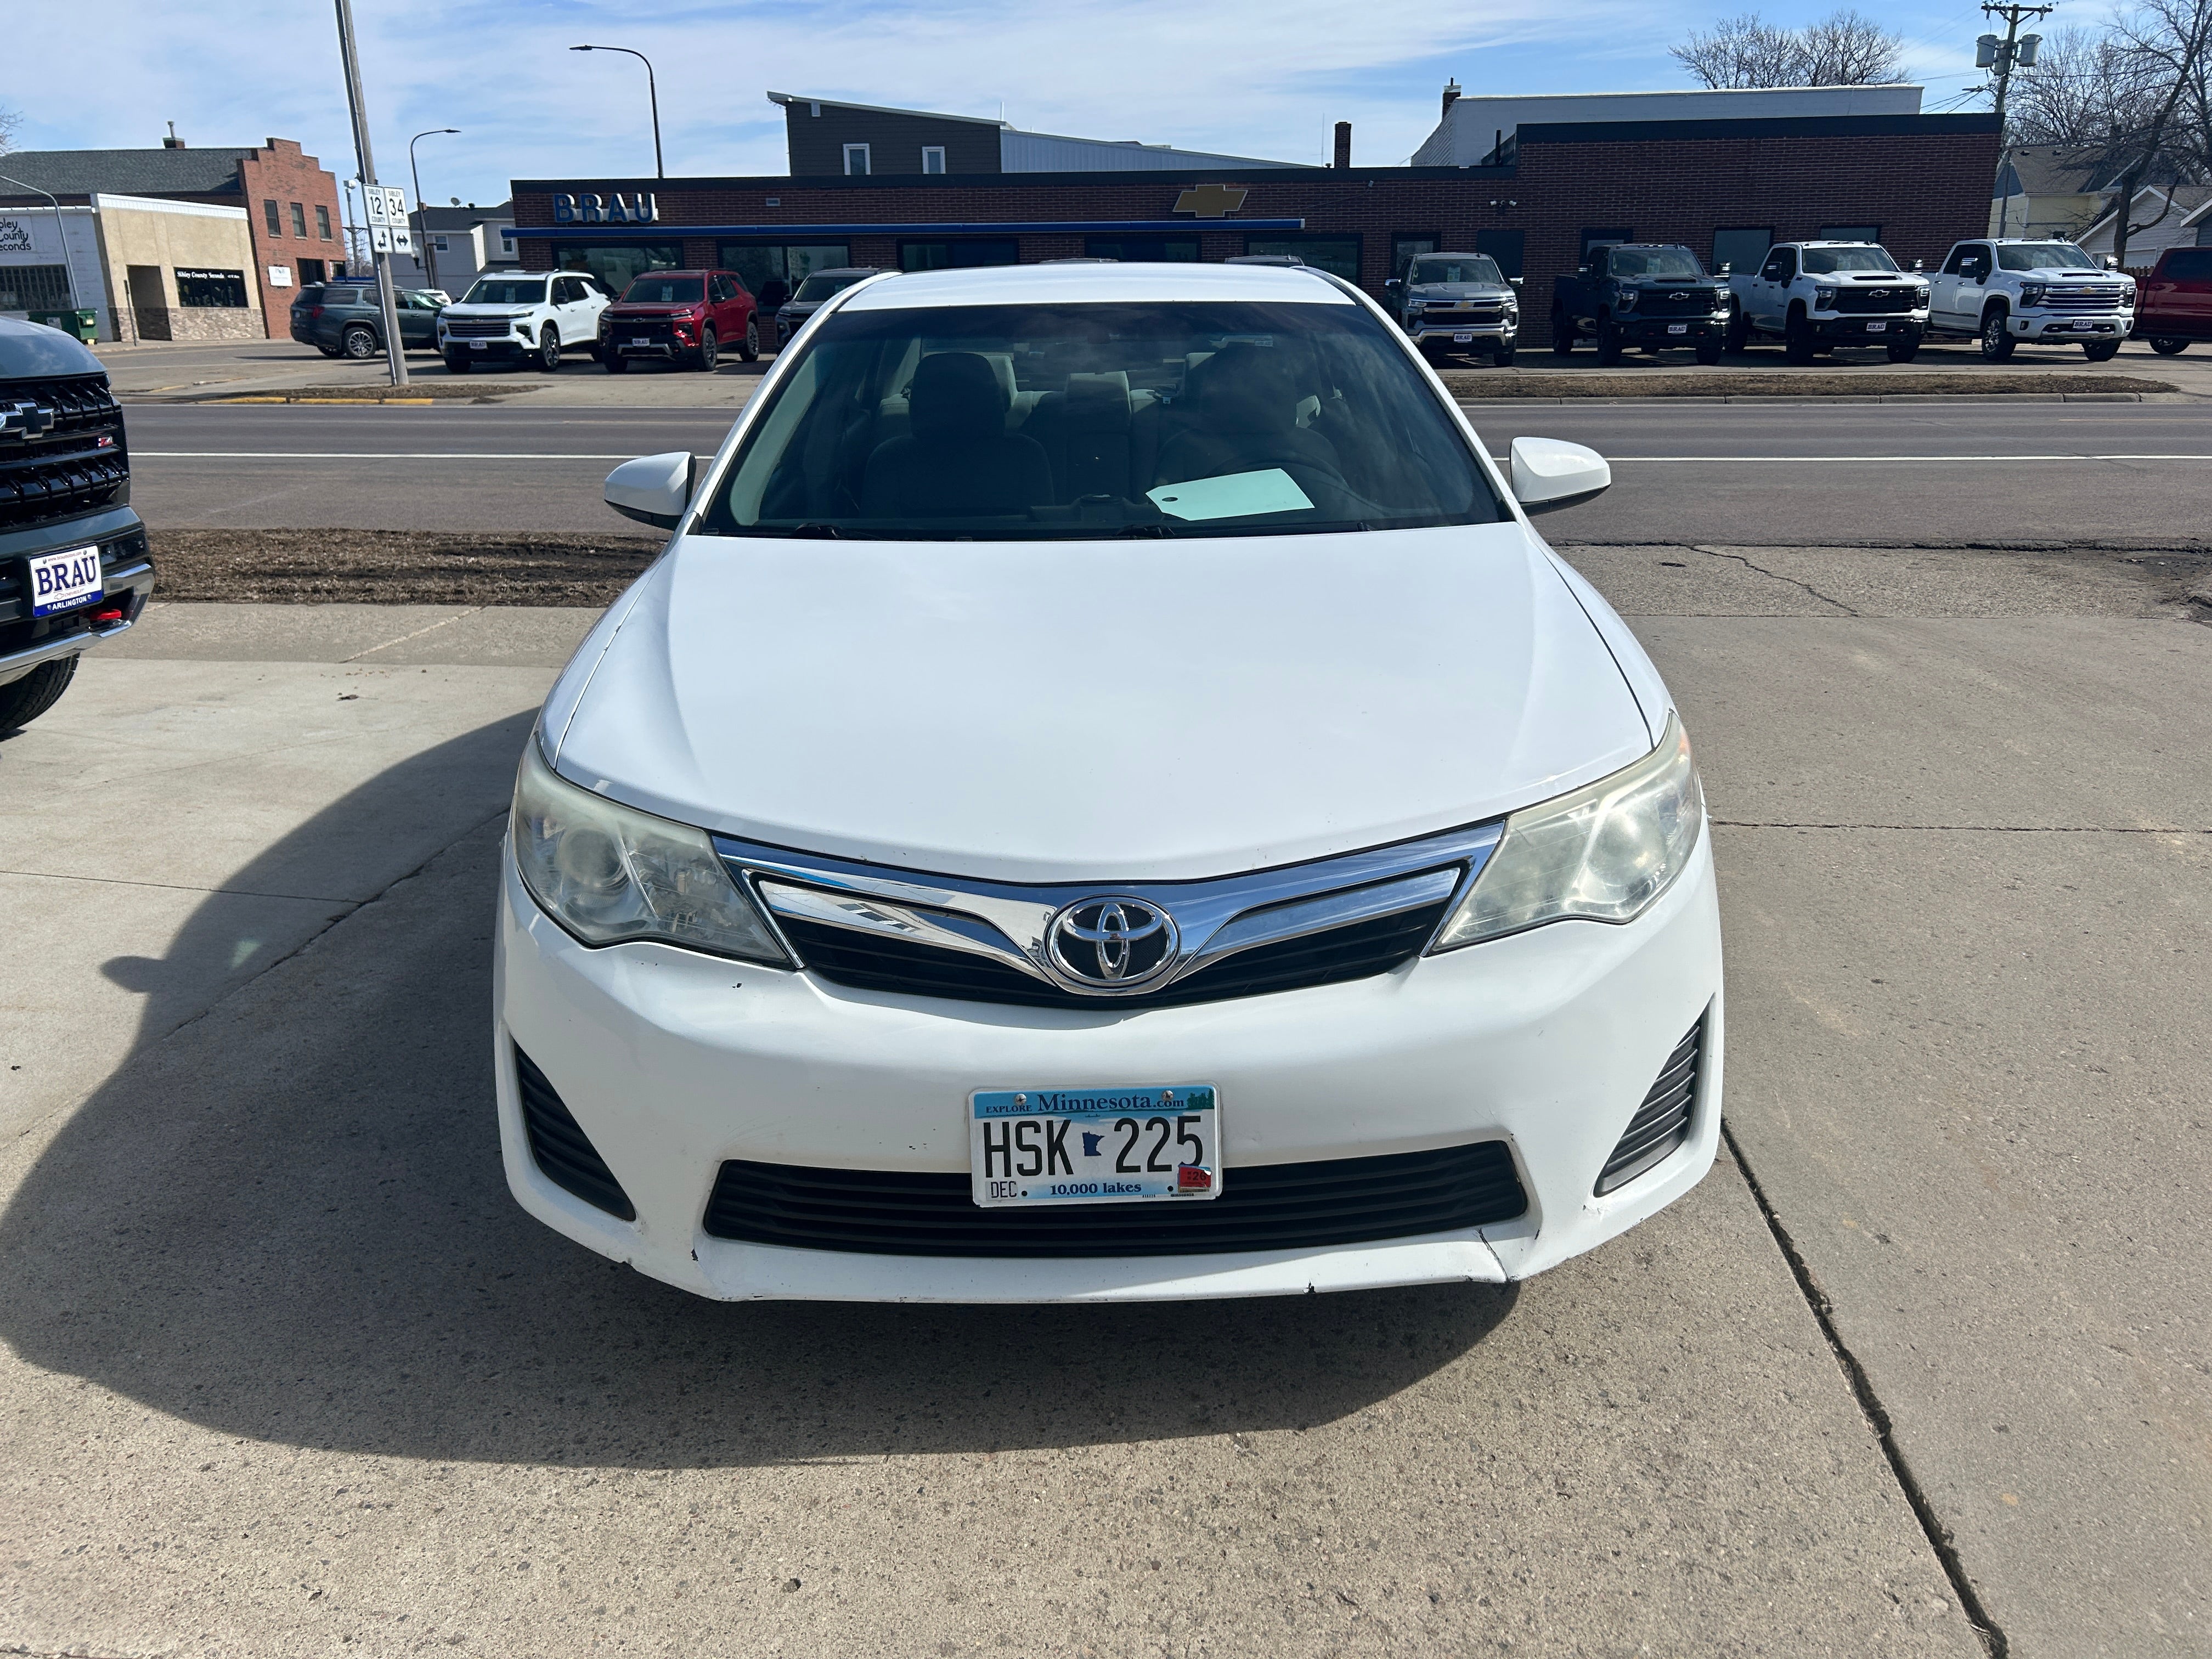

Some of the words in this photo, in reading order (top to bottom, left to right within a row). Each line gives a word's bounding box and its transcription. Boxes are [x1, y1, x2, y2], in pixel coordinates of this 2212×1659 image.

[370, 196, 383, 215] 12
[389, 198, 404, 217] 34
[554, 193, 658, 223] BRAU
[34, 554, 97, 597] BRAU
[52, 595, 87, 611] ARLINGTON
[986, 1104, 1032, 1114] EXPLORE
[1037, 1093, 1184, 1111] Minnesota.com
[984, 1119, 1074, 1178] HSK
[1114, 1115, 1204, 1173] 225
[991, 1181, 1017, 1199] DEC
[1050, 1183, 1098, 1197] 10,000
[1103, 1182, 1142, 1194] lakes
